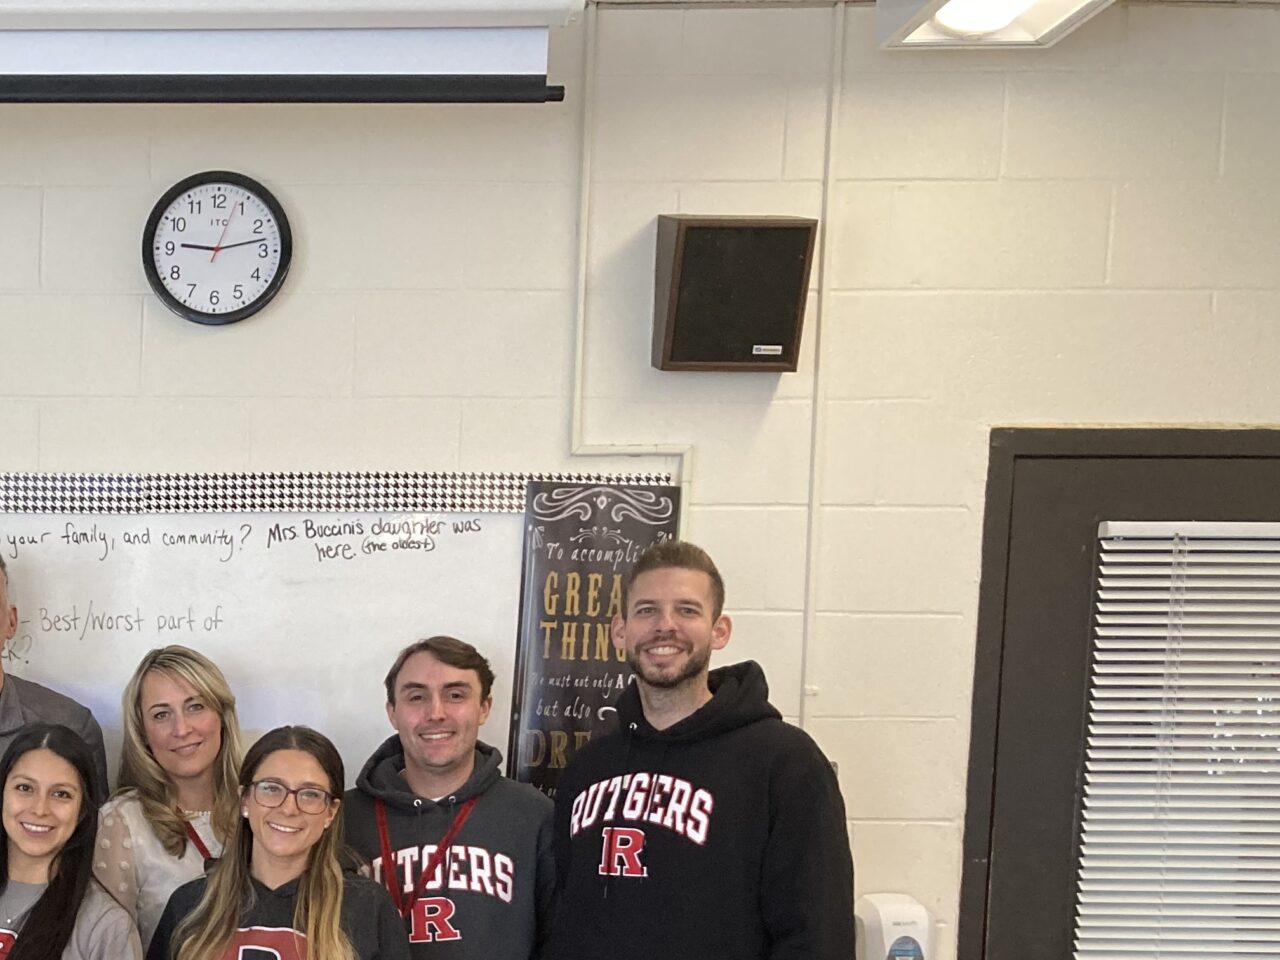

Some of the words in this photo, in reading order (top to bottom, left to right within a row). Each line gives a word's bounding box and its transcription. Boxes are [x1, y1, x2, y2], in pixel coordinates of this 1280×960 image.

[188, 200, 202, 215] 11
[211, 193, 227, 209] 12
[238, 202, 245, 216] 1
[170, 217, 186, 232] 10
[253, 219, 264, 234] 2
[165, 241, 176, 256] 9
[258, 244, 269, 259] 3
[170, 265, 181, 280] 8
[250, 267, 262, 282] 4
[186, 283, 197, 298] 7
[209, 290, 220, 305] 6
[233, 284, 243, 299] 5
[371, 517, 447, 543] daughter
[452, 518, 482, 535] was
[6, 532, 52, 559] your
[61, 522, 116, 561] family,
[123, 527, 151, 545] and
[162, 523, 252, 563] community?
[315, 543, 357, 562] here.
[546, 542, 564, 560] To
[571, 540, 645, 572] accompli
[543, 570, 622, 618] GREA
[157, 608, 195, 634] part
[204, 605, 224, 632] of
[540, 620, 627, 662] THIN
[536, 699, 558, 716] but
[564, 696, 591, 719] also
[570, 772, 714, 846] RUTGERS
[599, 827, 648, 877] R
[409, 896, 462, 943] R
